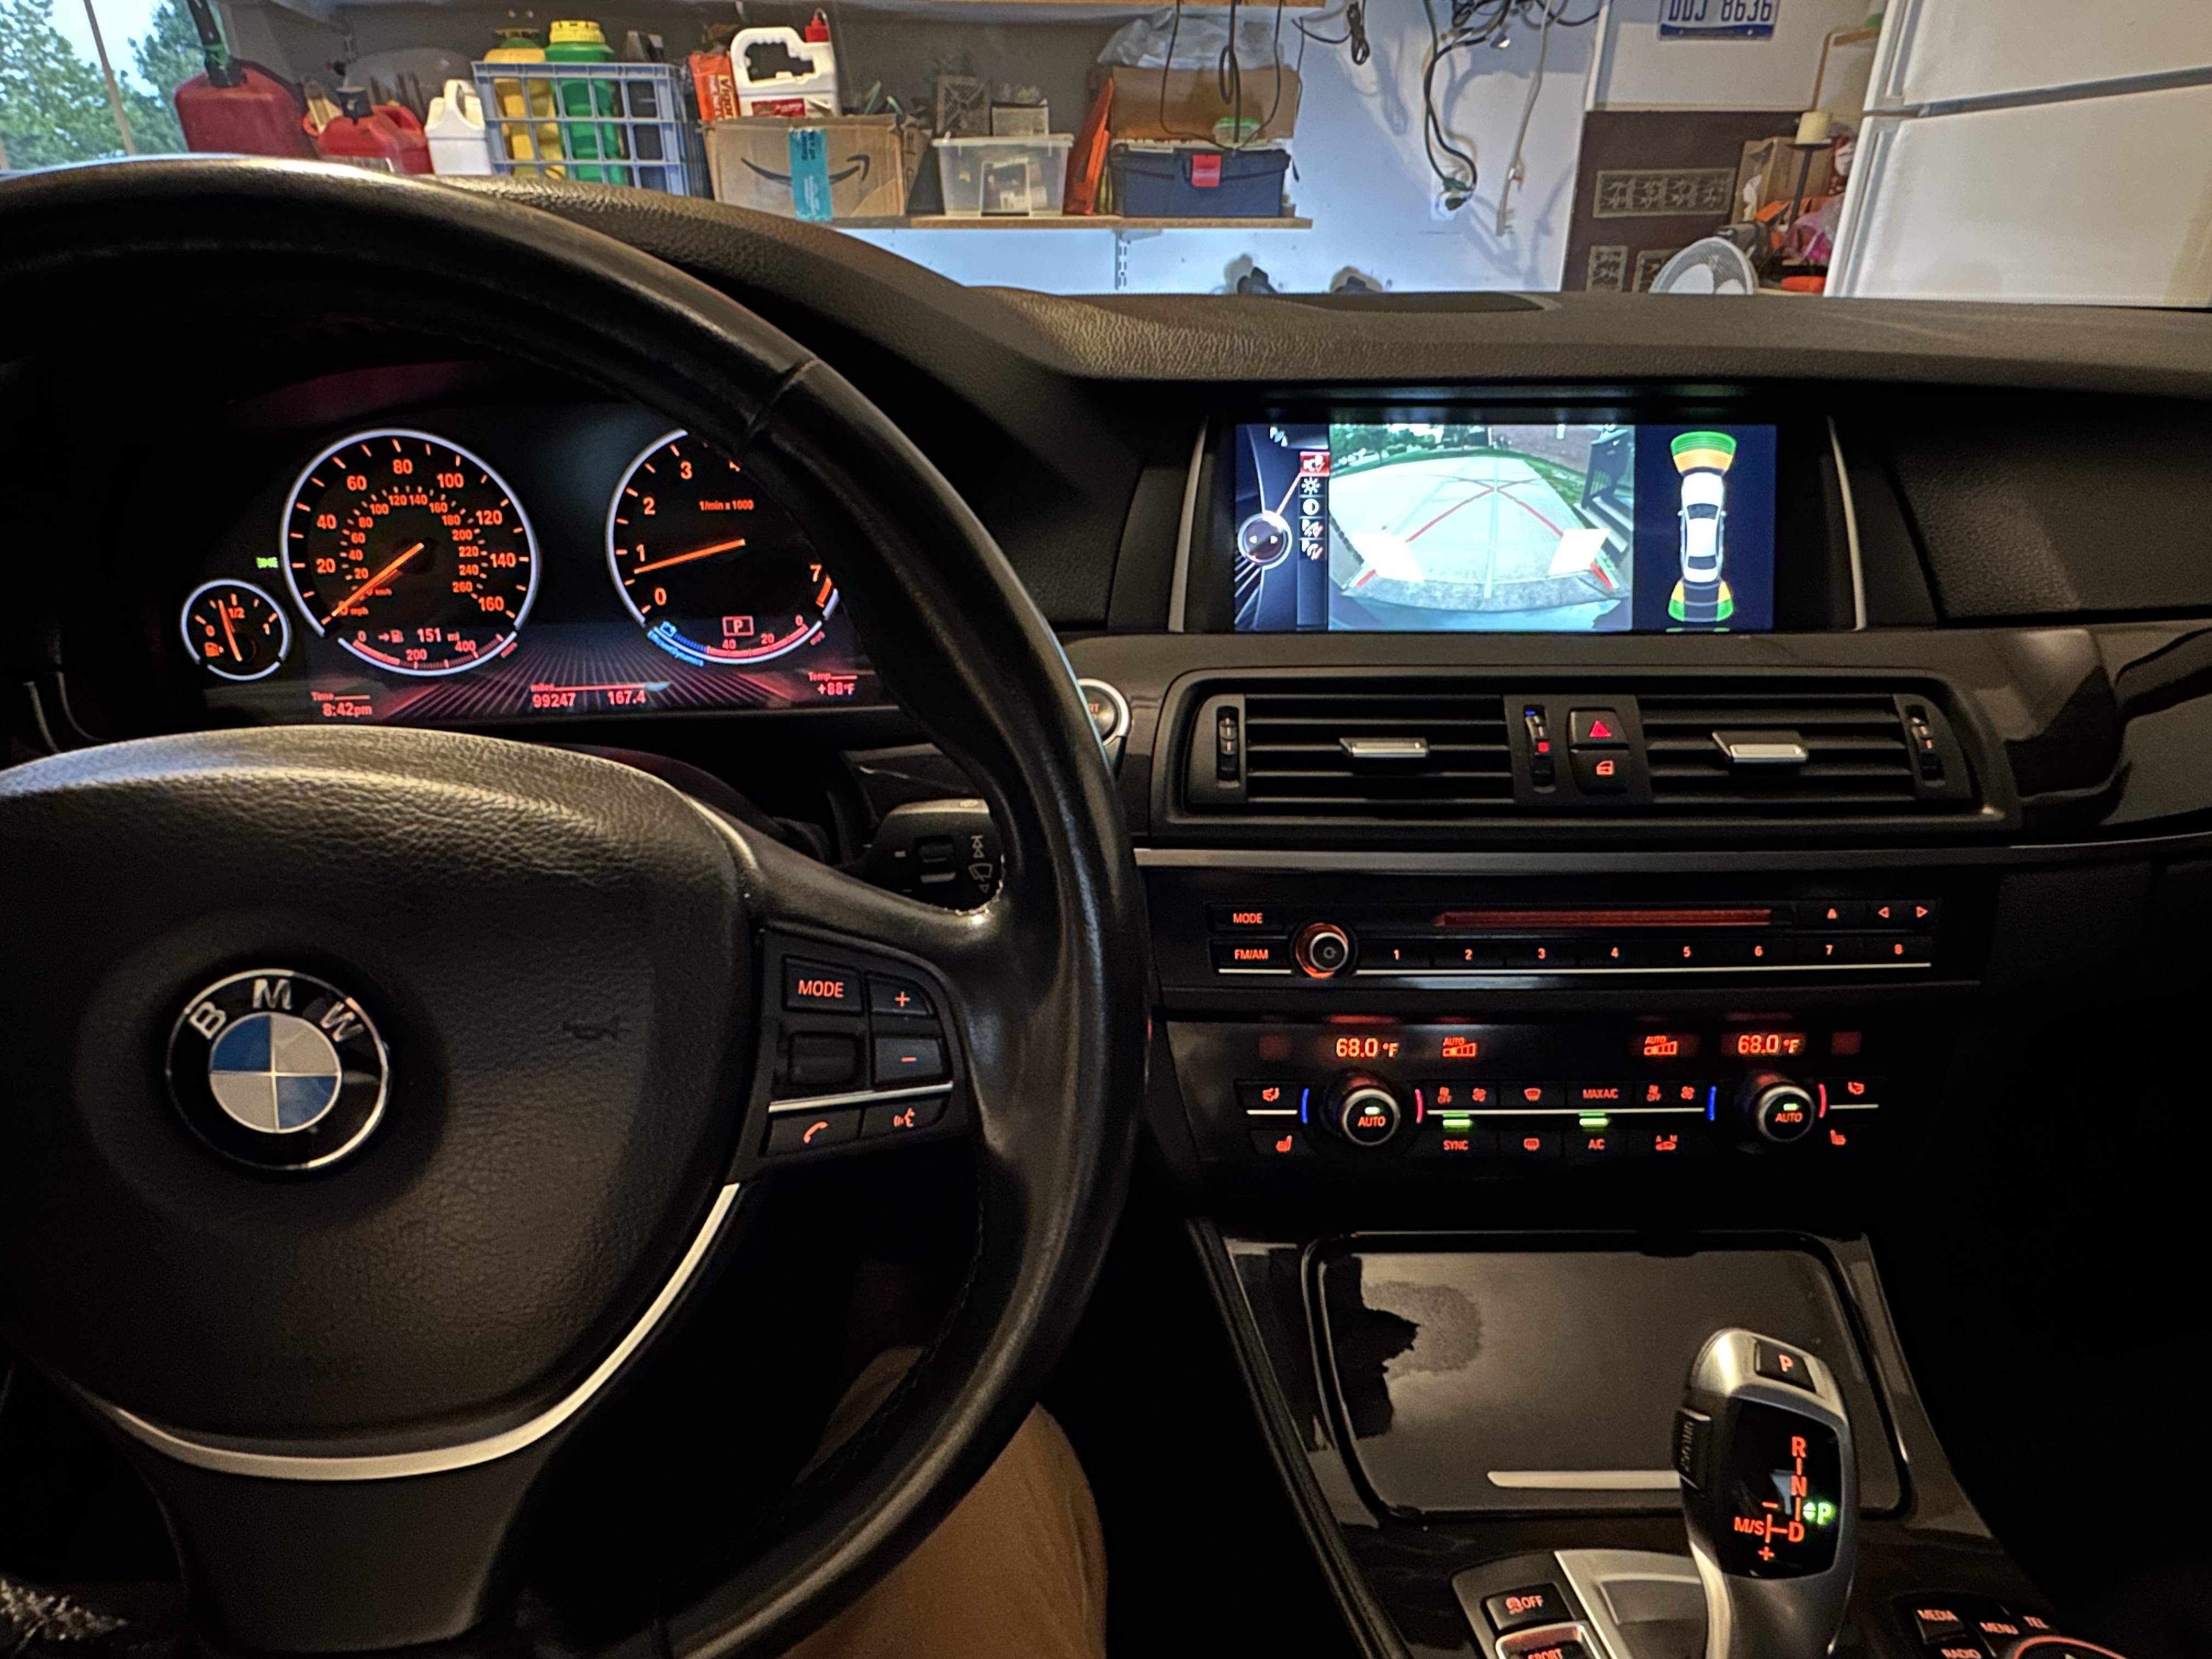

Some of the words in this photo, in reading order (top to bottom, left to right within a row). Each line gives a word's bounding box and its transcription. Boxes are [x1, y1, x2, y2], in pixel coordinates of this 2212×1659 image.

[393, 459, 413, 474] 80
[681, 461, 692, 479] 3
[347, 475, 367, 490] 60
[437, 473, 464, 488] 100
[387, 495, 407, 506] 120
[409, 494, 427, 505] 140
[644, 496, 655, 515] 2
[732, 499, 754, 510] 1000
[369, 502, 390, 515] 100
[429, 502, 448, 513] 160
[317, 514, 336, 529] 40
[357, 515, 373, 528] 80
[442, 513, 462, 525] 180
[475, 509, 503, 526] 120
[349, 532, 365, 543] 60
[452, 529, 474, 540] 200
[348, 549, 363, 561] 40
[459, 546, 479, 557] 220
[636, 544, 645, 561] 1
[316, 558, 336, 573] 20
[489, 552, 517, 568] 140
[354, 568, 368, 579] 20
[459, 565, 479, 575] 240
[810, 565, 821, 582] 7
[452, 581, 473, 594] 260
[654, 588, 667, 605] 0
[477, 596, 504, 612] 160
[228, 607, 245, 619] 1/2
[733, 620, 743, 633] P
[795, 616, 803, 626] 0
[205, 624, 215, 637] 0
[263, 623, 270, 635] 1
[417, 628, 441, 642] 151
[447, 632, 460, 642] mi
[357, 630, 366, 642] 0
[761, 633, 775, 645] 20
[455, 640, 477, 652] 400
[722, 639, 737, 650] 40
[405, 648, 428, 661] 200
[532, 692, 576, 708] 99247
[607, 690, 646, 706] 167.4
[323, 702, 373, 717] 8:42pm
[1233, 913, 1262, 923] MODE
[1235, 950, 1268, 960] FM/AM
[1394, 950, 1399, 960] 1
[1465, 949, 1472, 960] 2
[1538, 948, 1545, 959] 3
[1611, 947, 1618, 957] 4
[1684, 946, 1691, 957] 5
[1755, 946, 1763, 956] 6
[1826, 945, 1833, 955] 7
[1894, 944, 1903, 954] 8
[798, 980, 843, 997] MODE
[189, 979, 363, 1040] BMW
[1443, 1036, 1465, 1045] AUTO
[1645, 1035, 1667, 1043] AUTO
[1737, 1034, 1779, 1054] 68.0
[1336, 1038, 1379, 1057] 68.0
[1358, 1114, 1385, 1127] AUTO
[1775, 1111, 1802, 1123] AUTO
[1443, 1140, 1468, 1150] SYNC
[1588, 1138, 1604, 1149] A/C
[1779, 1355, 1793, 1372] P
[1792, 1436, 1806, 1458] R
[1791, 1475, 1807, 1497] N
[1817, 1502, 1835, 1525] P
[1734, 1516, 1764, 1536] M/S
[1788, 1521, 1805, 1543] D
[1521, 1595, 1543, 1610] OFF
[1917, 1610, 1957, 1621] MEDIA
[1980, 1622, 2018, 1634] MENU
[2024, 1616, 2049, 1629] TEL
[1940, 1648, 1982, 1659] RADIO
